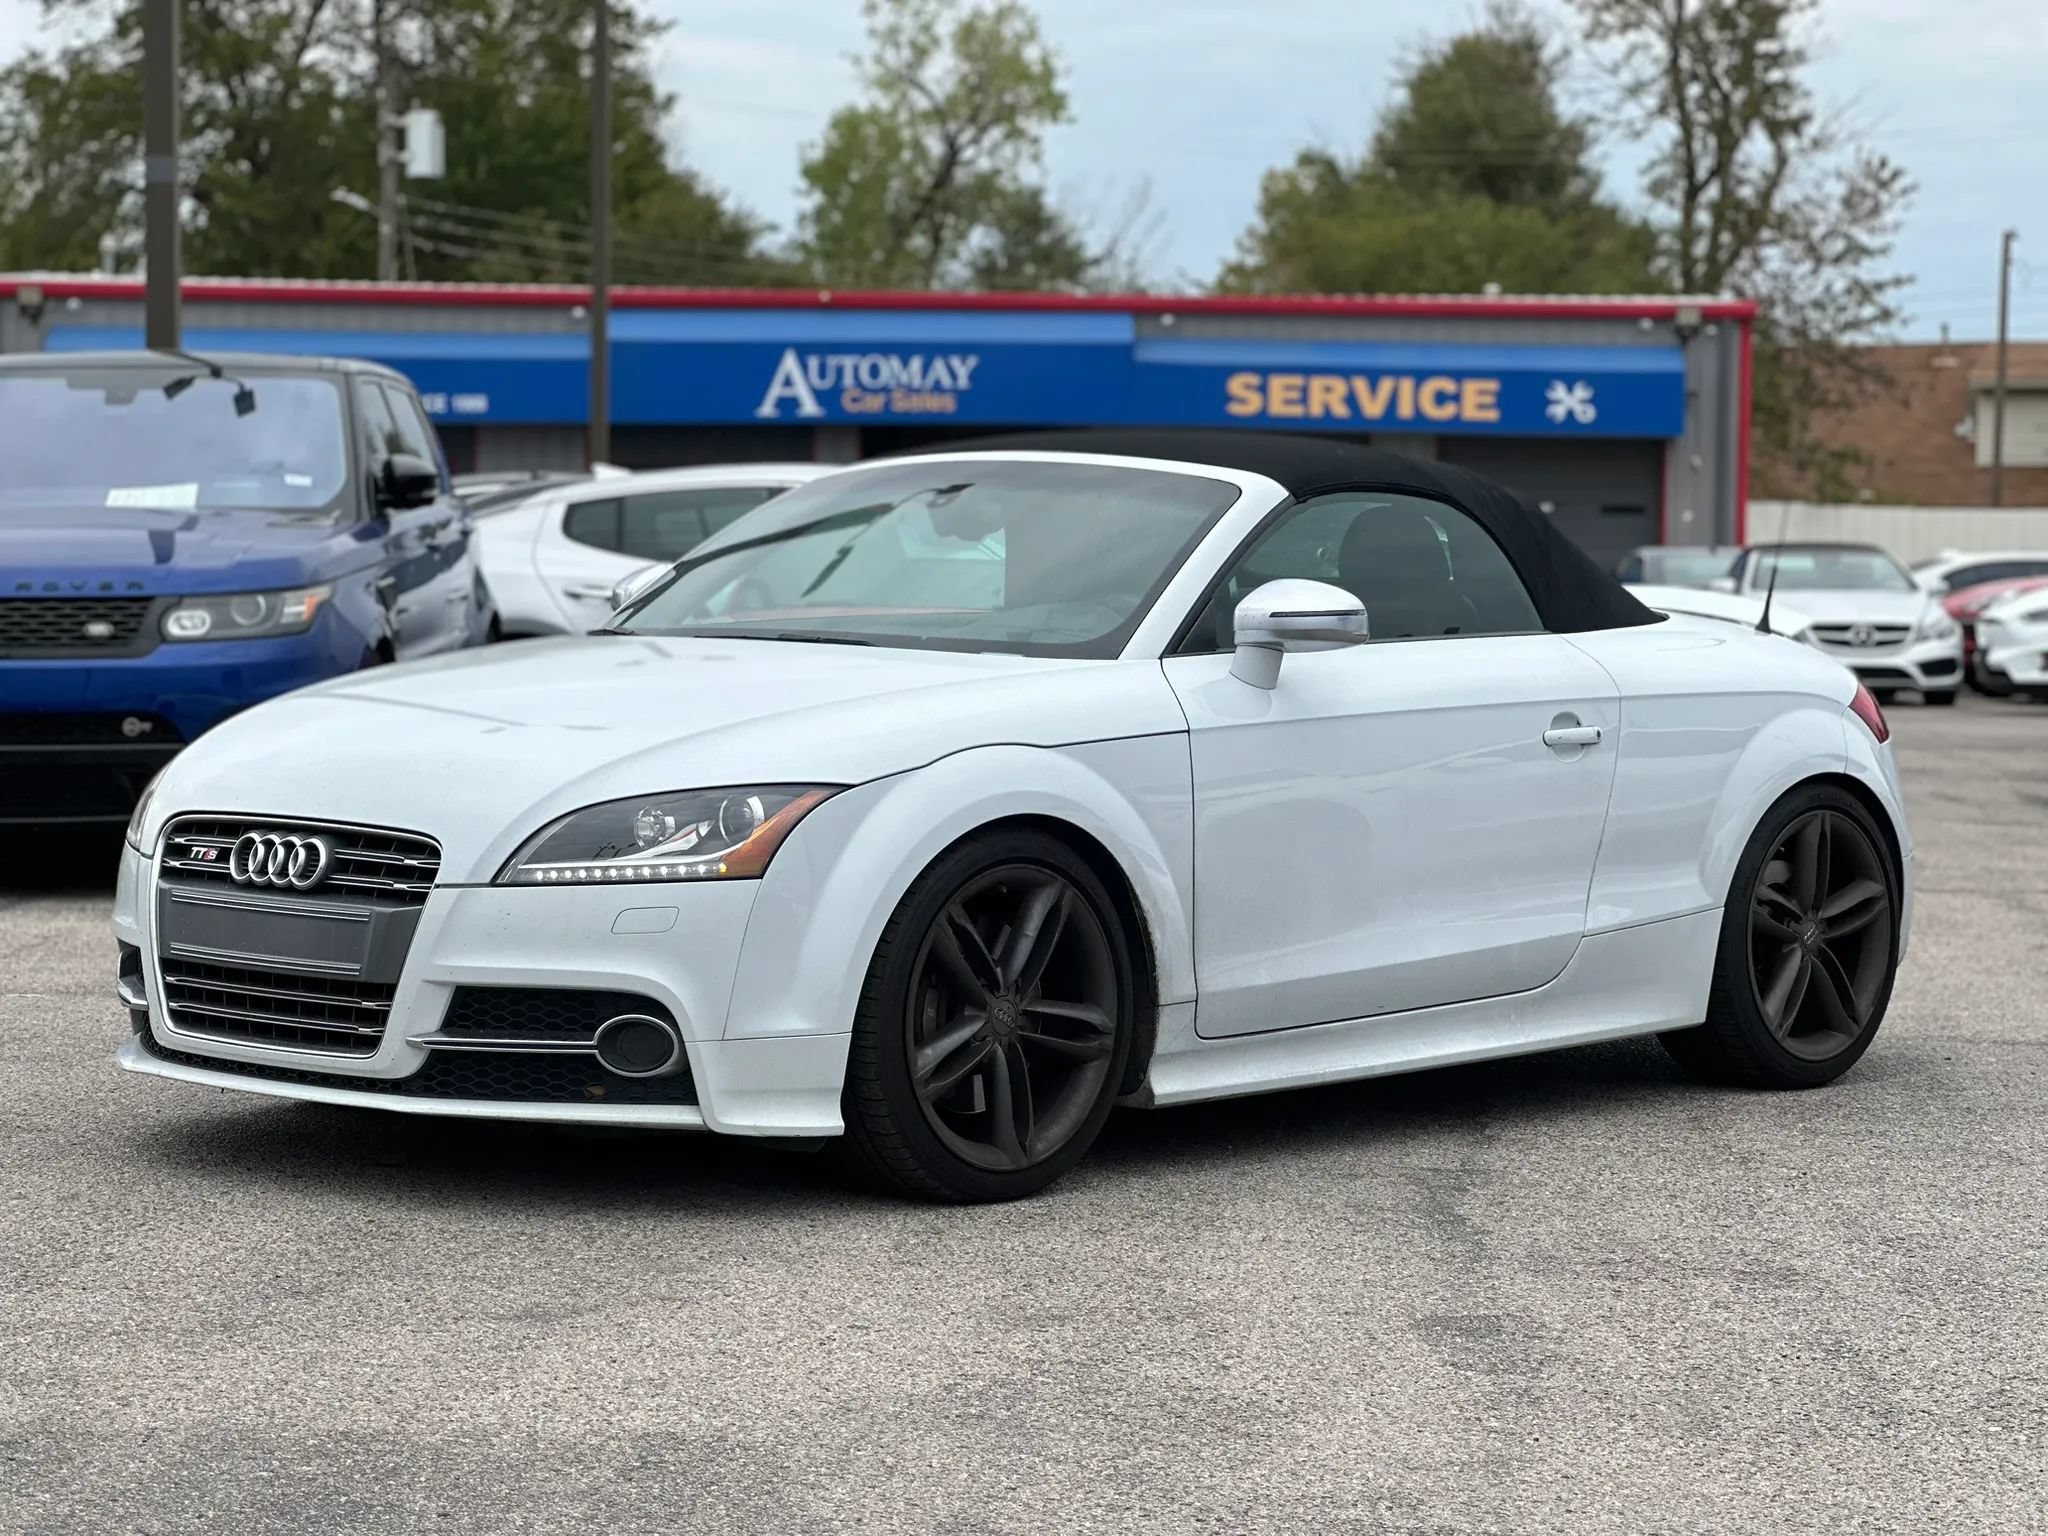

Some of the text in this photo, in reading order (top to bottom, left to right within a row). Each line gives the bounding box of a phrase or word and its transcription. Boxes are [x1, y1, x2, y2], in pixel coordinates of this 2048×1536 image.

[754, 347, 981, 417] AUTOMAY
[841, 387, 886, 413] Car
[1225, 372, 1501, 421] SERVICE
[15, 580, 144, 592] ROVER
[190, 846, 218, 860] TTS
